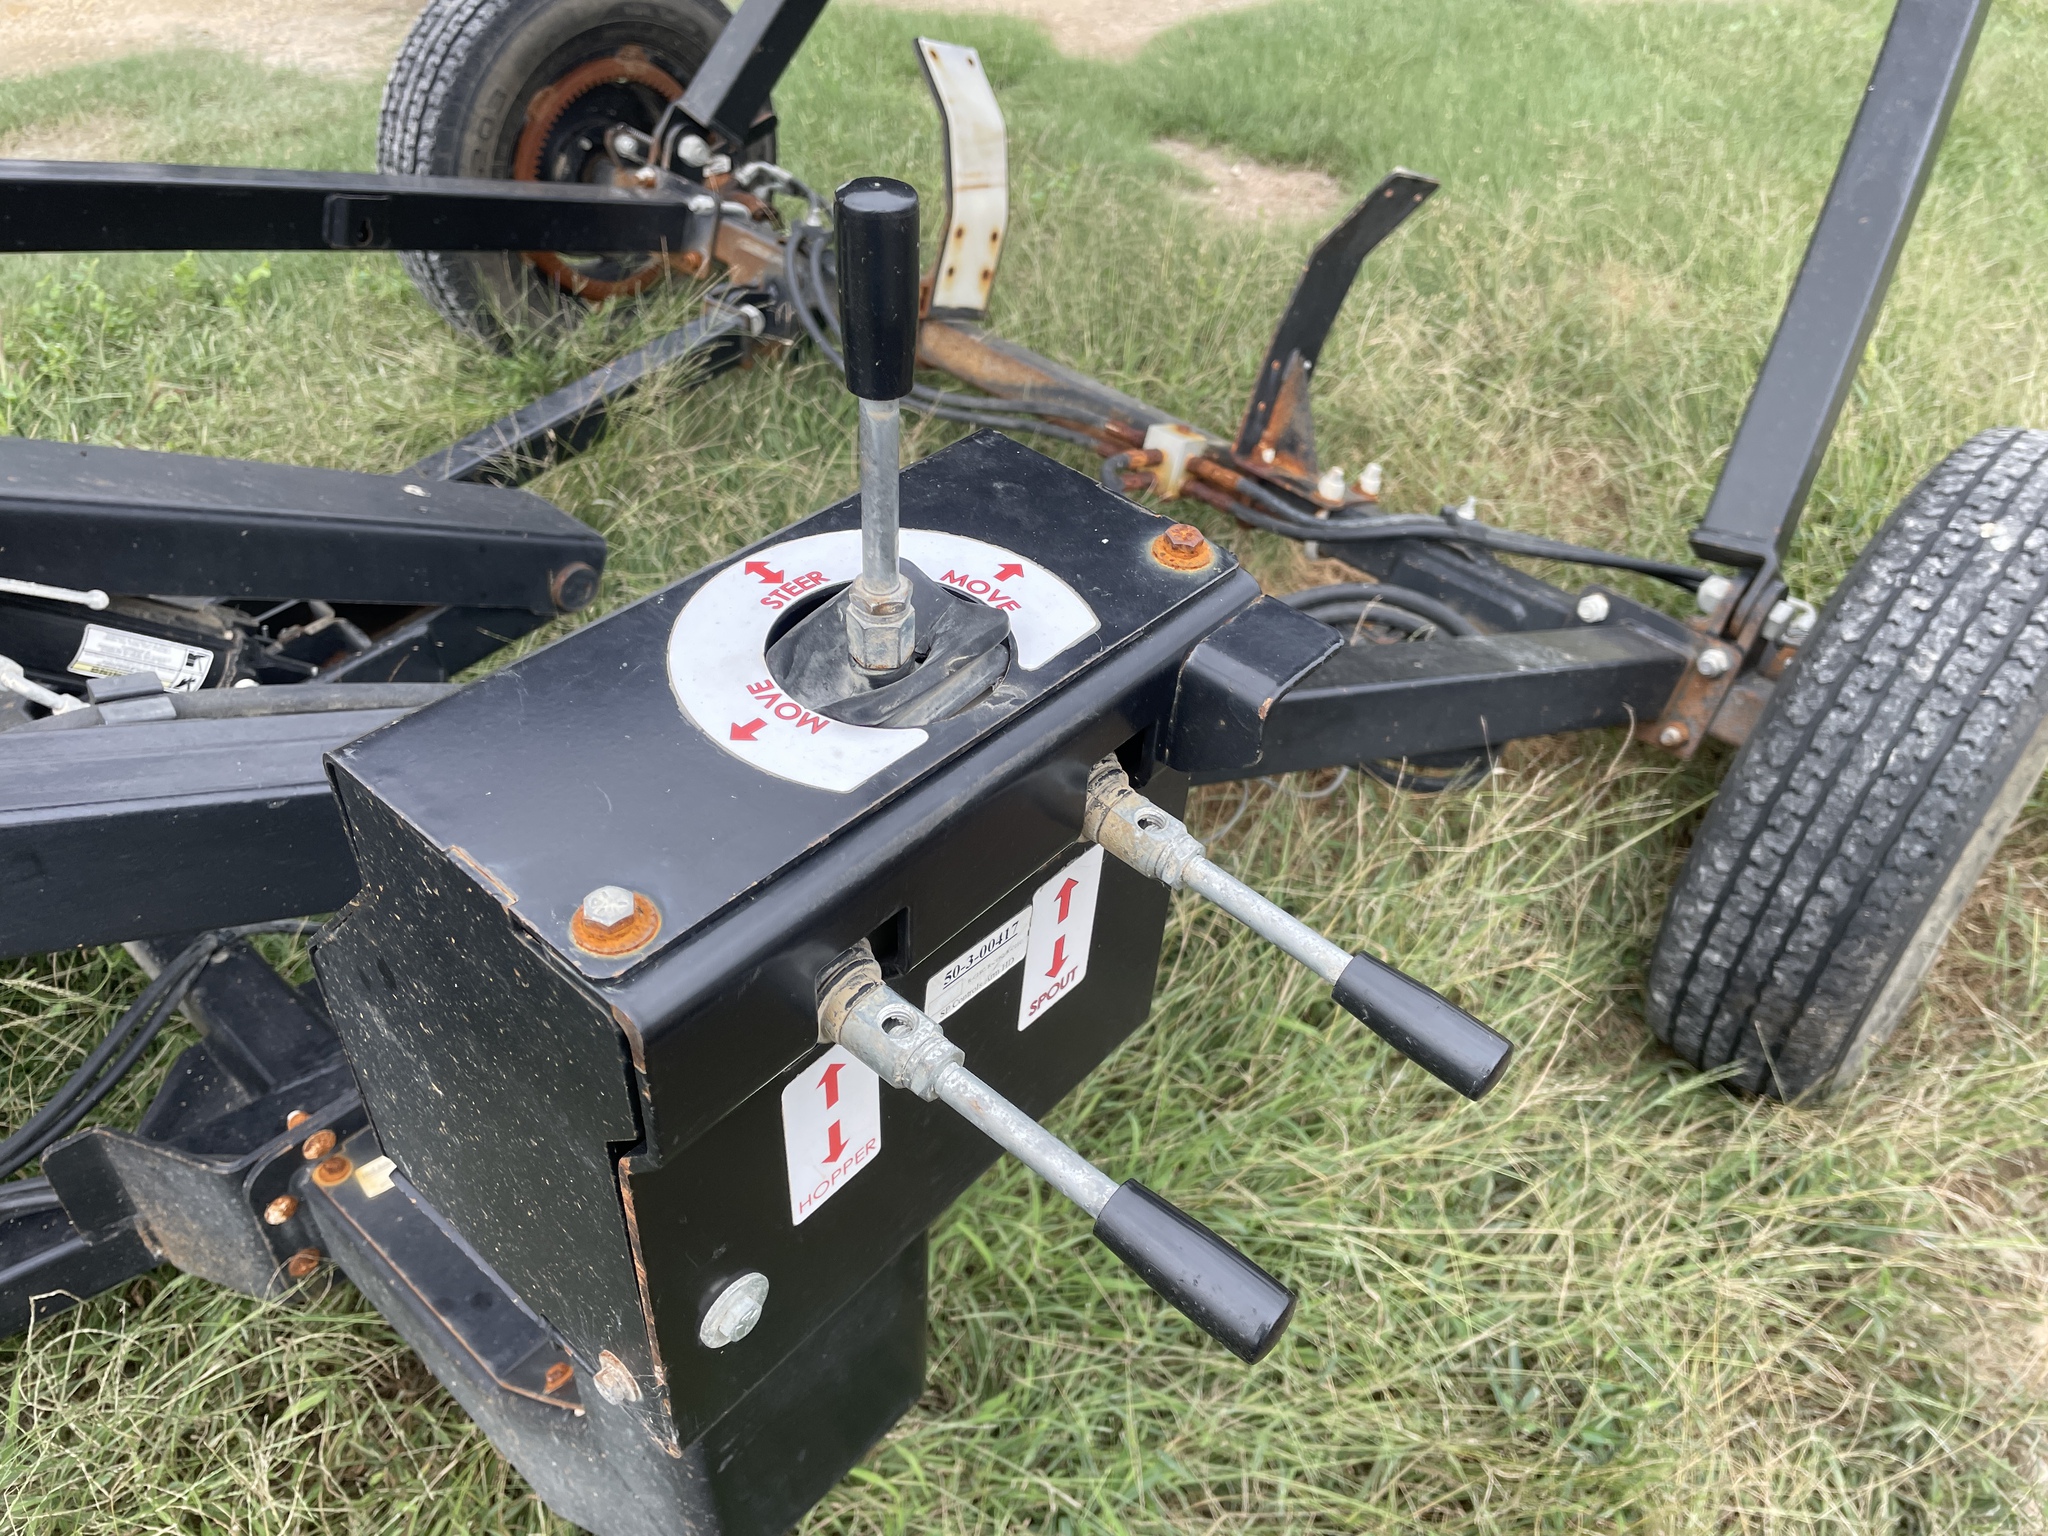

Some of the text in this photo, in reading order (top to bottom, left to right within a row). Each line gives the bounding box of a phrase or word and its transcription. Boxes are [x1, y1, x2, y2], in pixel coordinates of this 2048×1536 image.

[760, 570, 831, 610] STEER
[940, 569, 1022, 613] MOVE
[746, 678, 830, 735] MOVE
[943, 920, 1019, 986] 50-3-00417
[1028, 965, 1079, 1017] SPOUT
[799, 1137, 876, 1214] HOPPER
